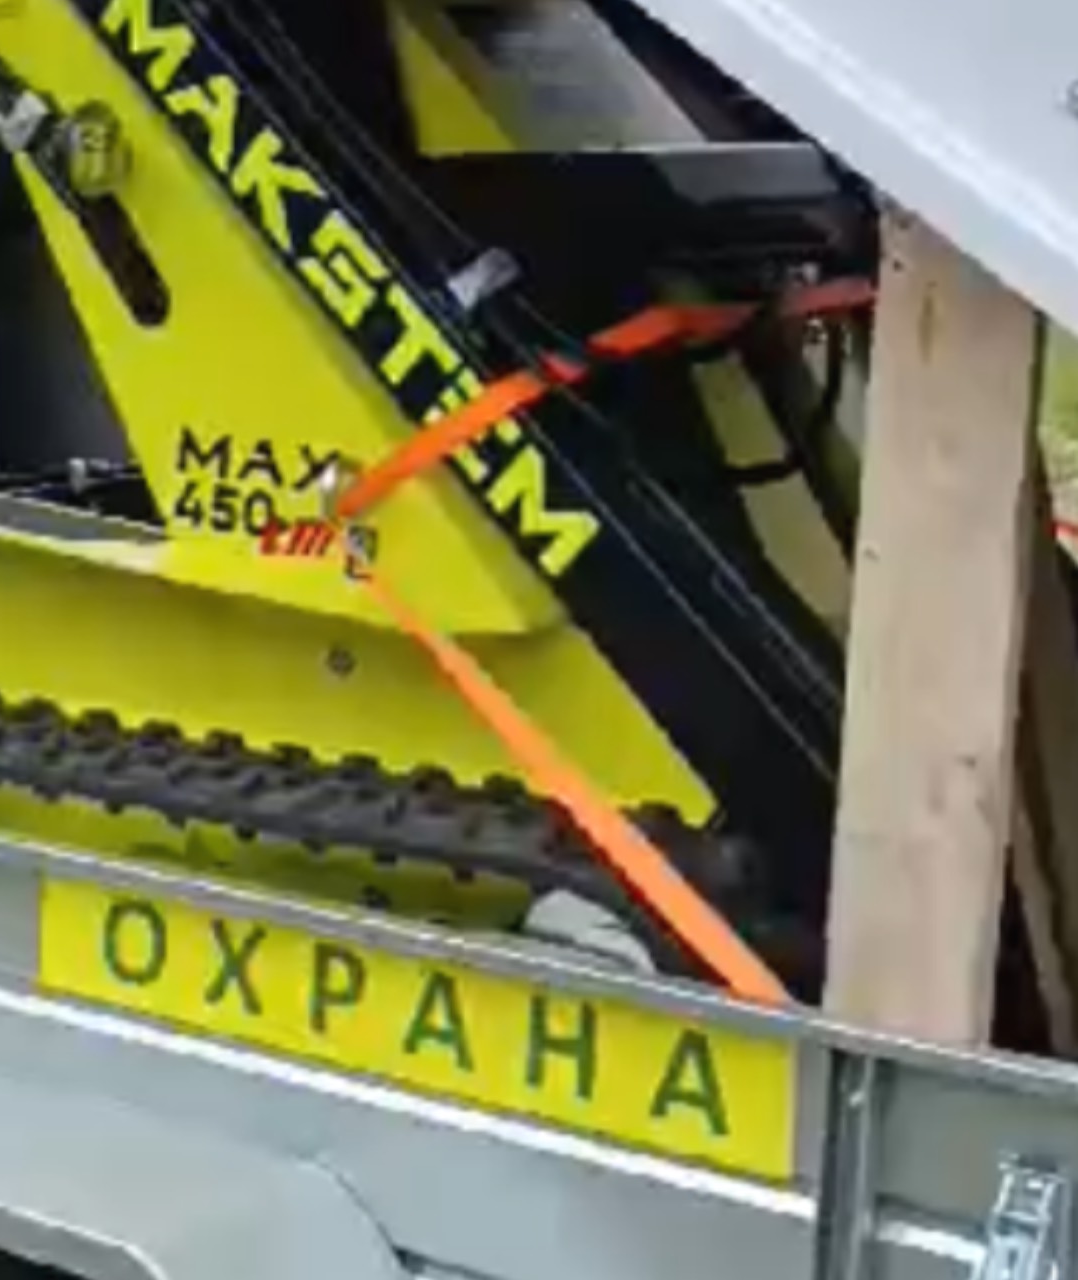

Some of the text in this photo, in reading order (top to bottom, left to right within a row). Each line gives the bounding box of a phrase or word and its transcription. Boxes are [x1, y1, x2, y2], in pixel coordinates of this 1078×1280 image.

[176, 426, 341, 491] MAX
[175, 480, 273, 536] 450
[102, 898, 729, 1136] ОХРАНА
